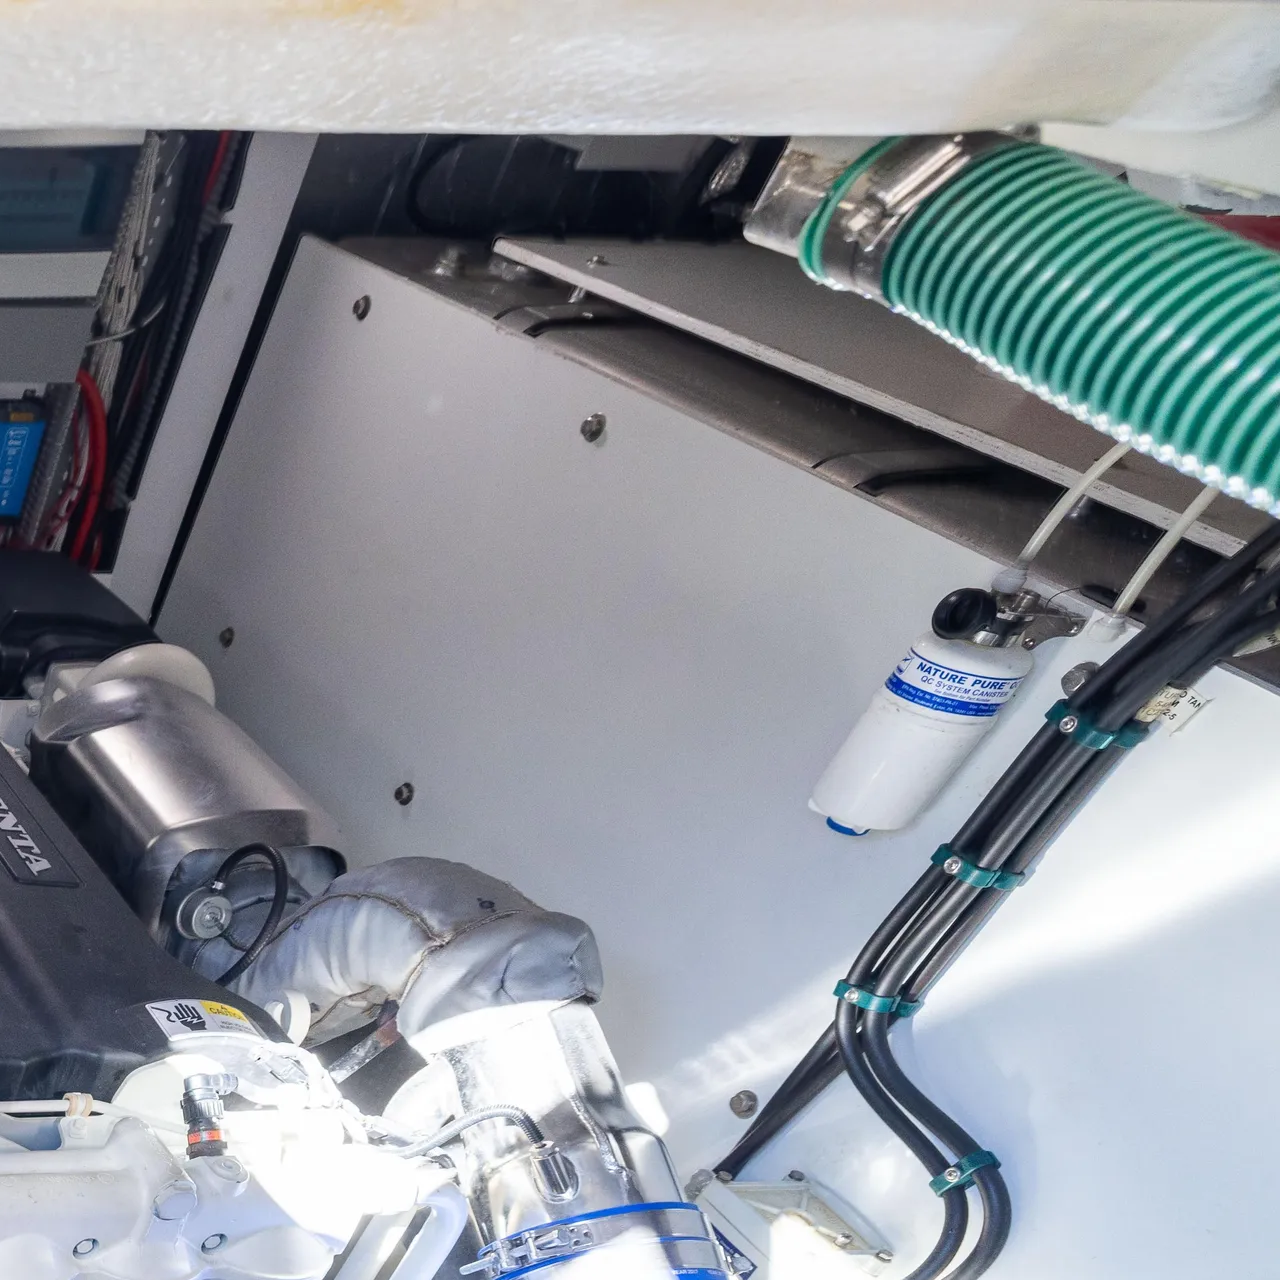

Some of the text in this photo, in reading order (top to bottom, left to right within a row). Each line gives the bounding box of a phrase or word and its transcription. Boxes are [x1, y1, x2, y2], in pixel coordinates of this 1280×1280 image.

[916, 662, 968, 685] NATURE
[971, 678, 1007, 690] PURE
[921, 675, 935, 685] QC
[935, 681, 970, 695] SYSTEM
